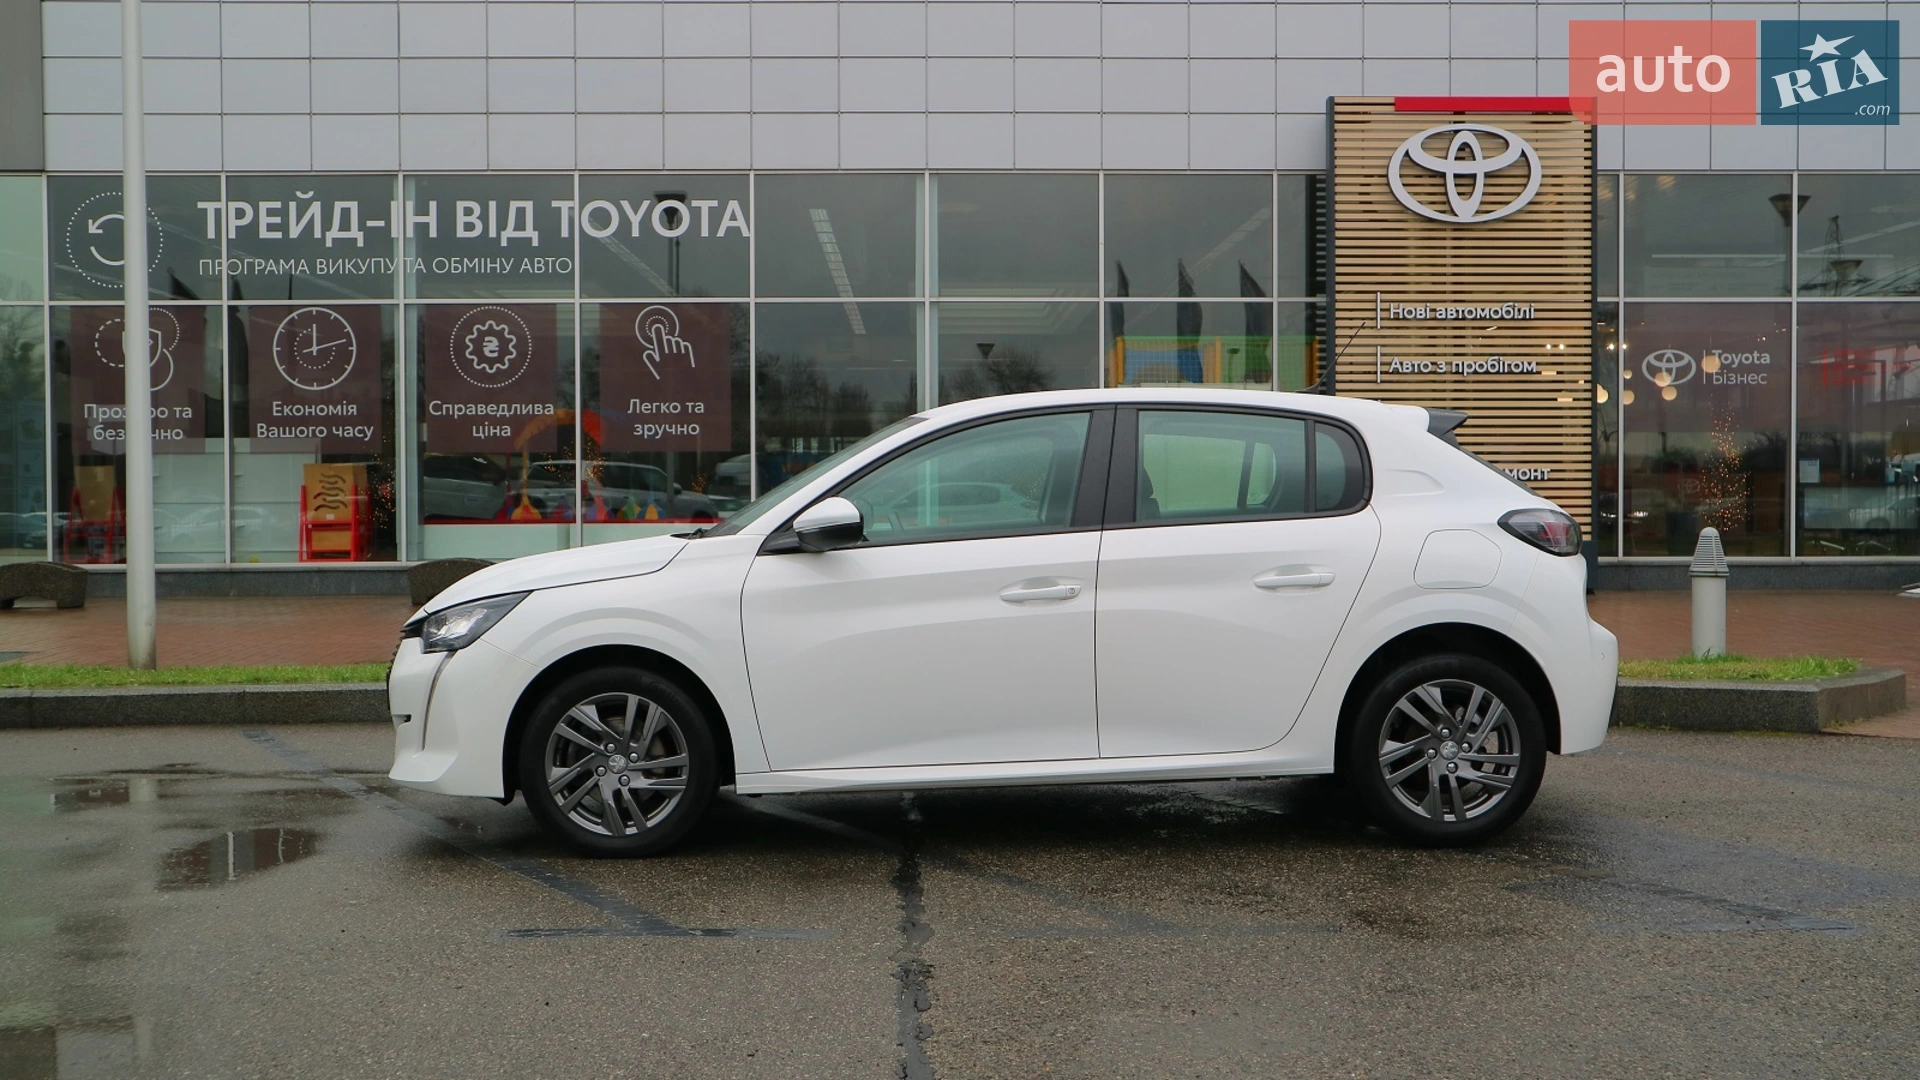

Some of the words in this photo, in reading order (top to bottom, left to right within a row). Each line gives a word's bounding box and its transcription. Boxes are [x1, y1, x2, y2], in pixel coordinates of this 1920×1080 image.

[197, 190, 437, 247] ТРЕЙД-ІН
[456, 200, 539, 246] ВІД
[552, 199, 750, 238] TOYOTA
[200, 259, 309, 276] ПРОГРАМА
[316, 258, 397, 276] ВИКУПУ
[402, 258, 426, 274] ТА
[432, 257, 514, 274] ОБМІНУ
[520, 257, 572, 274] АВТО
[1389, 302, 1430, 319] Нові
[1436, 302, 1535, 319] автомобілі
[1389, 357, 1432, 373] Авто
[1452, 356, 1537, 376] пробігом
[1712, 350, 1771, 369] Toyota
[1712, 371, 1767, 385] Бізнес
[173, 407, 192, 419] та
[272, 400, 358, 417] Економія
[429, 400, 554, 419] Справедлива
[627, 398, 681, 415] Легко
[685, 401, 705, 415] та
[256, 423, 327, 439] Вашого
[332, 426, 375, 442] часу
[472, 422, 512, 440] ціна
[634, 422, 700, 440] зручно
